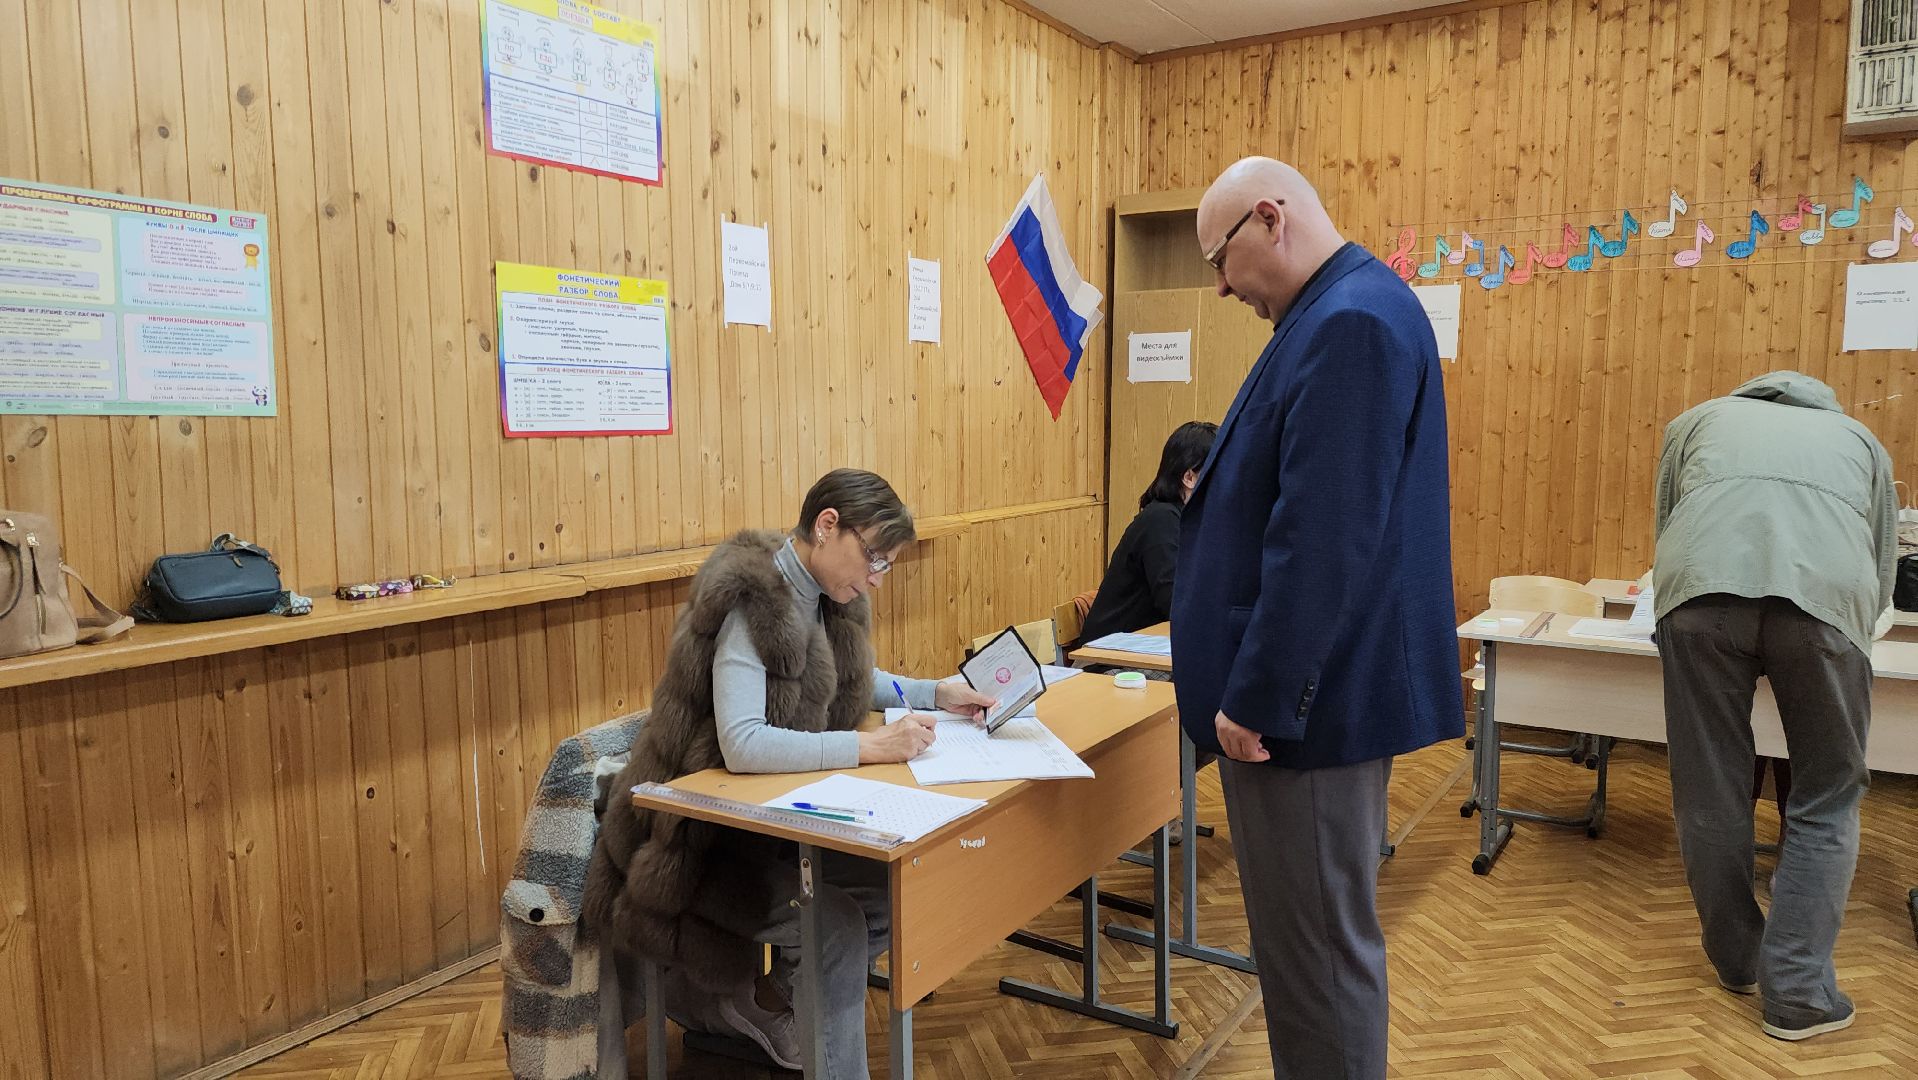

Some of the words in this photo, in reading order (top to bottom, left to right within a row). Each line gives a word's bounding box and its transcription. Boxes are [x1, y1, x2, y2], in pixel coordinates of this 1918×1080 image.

[76, 197, 145, 213] ОРФОГРАММЫ
[147, 206, 153, 214] В
[155, 207, 184, 218] КОРНЕ
[185, 211, 214, 223] СЛОВА
[557, 273, 620, 288] ФОНЕТИЧЕСКИЙ
[559, 286, 589, 296] РАЗБОР
[593, 289, 619, 299] СЛОВА
[1141, 342, 1163, 350] Места
[1163, 342, 1178, 350] для
